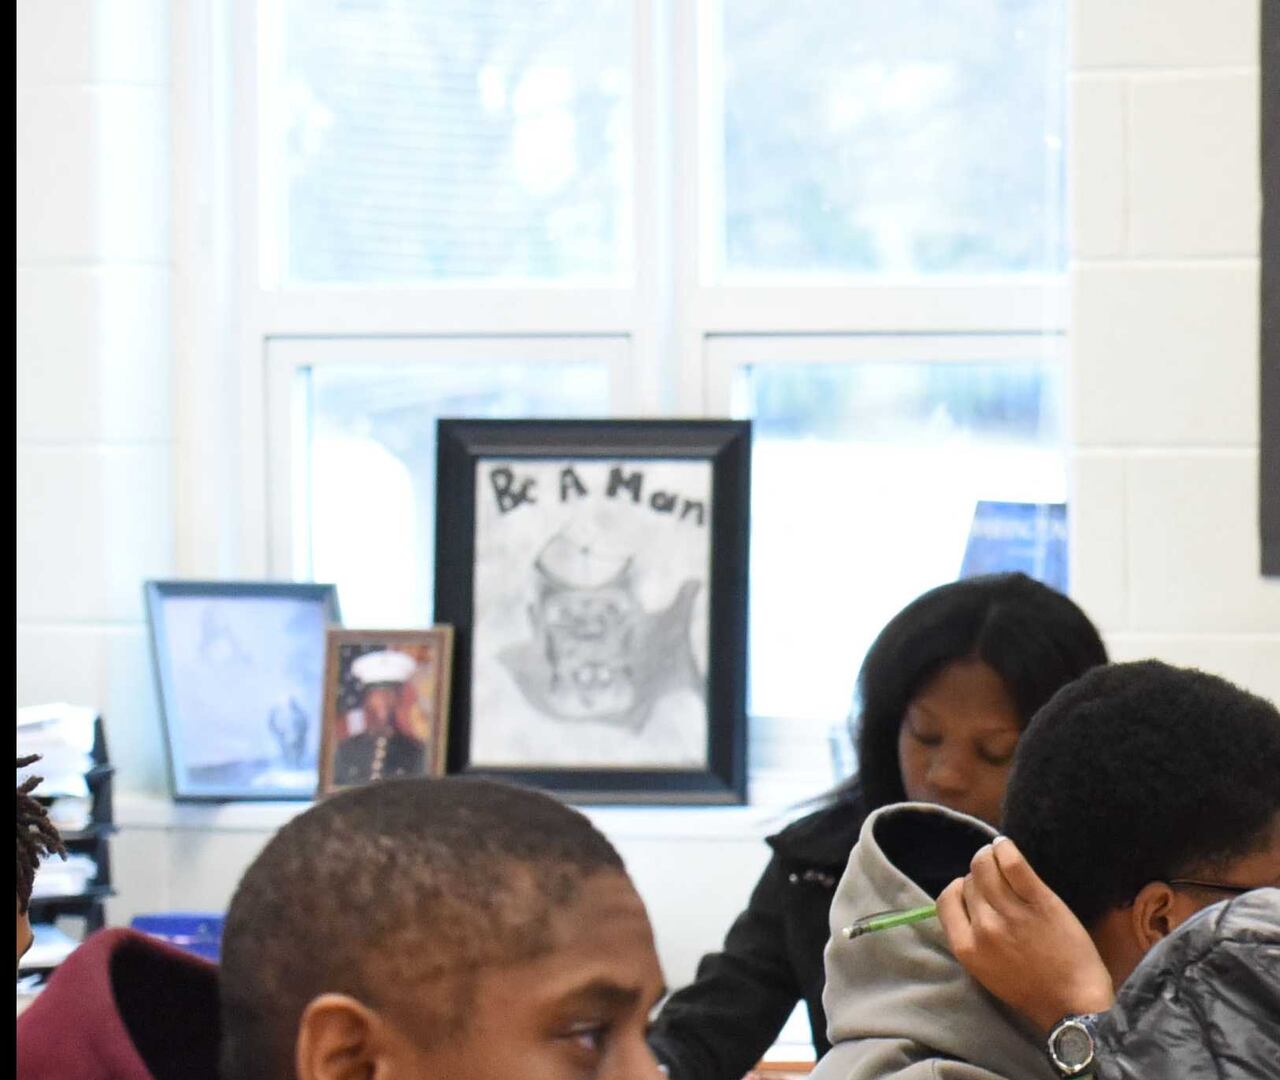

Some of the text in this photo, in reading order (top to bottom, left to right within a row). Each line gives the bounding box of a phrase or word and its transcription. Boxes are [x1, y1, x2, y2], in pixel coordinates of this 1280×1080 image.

[490, 467, 704, 526] Be A Man
